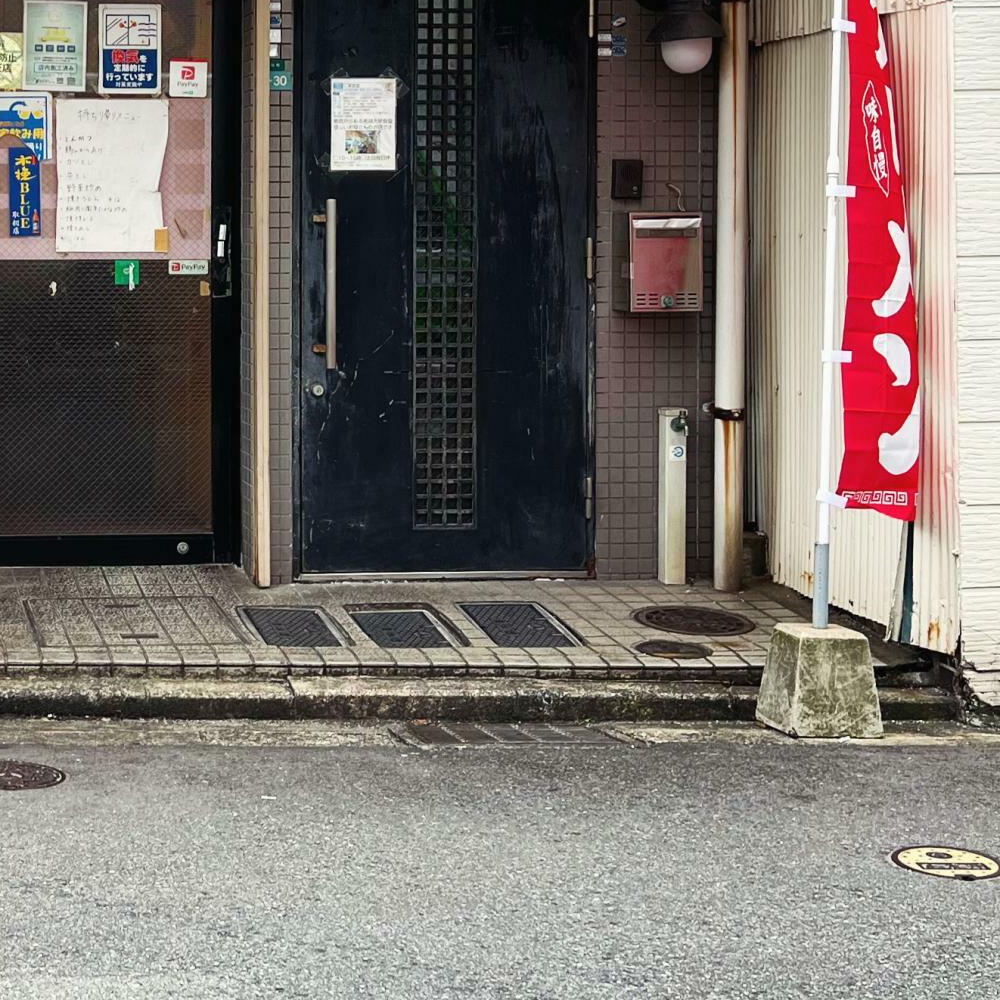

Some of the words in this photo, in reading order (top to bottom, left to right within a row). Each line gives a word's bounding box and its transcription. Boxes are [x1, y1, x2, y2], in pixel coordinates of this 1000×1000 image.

[111, 49, 147, 64] 換気を
[113, 64, 146, 72] 定期的に
[105, 73, 154, 82] 行っています
[865, 96, 888, 180] 味自慢
